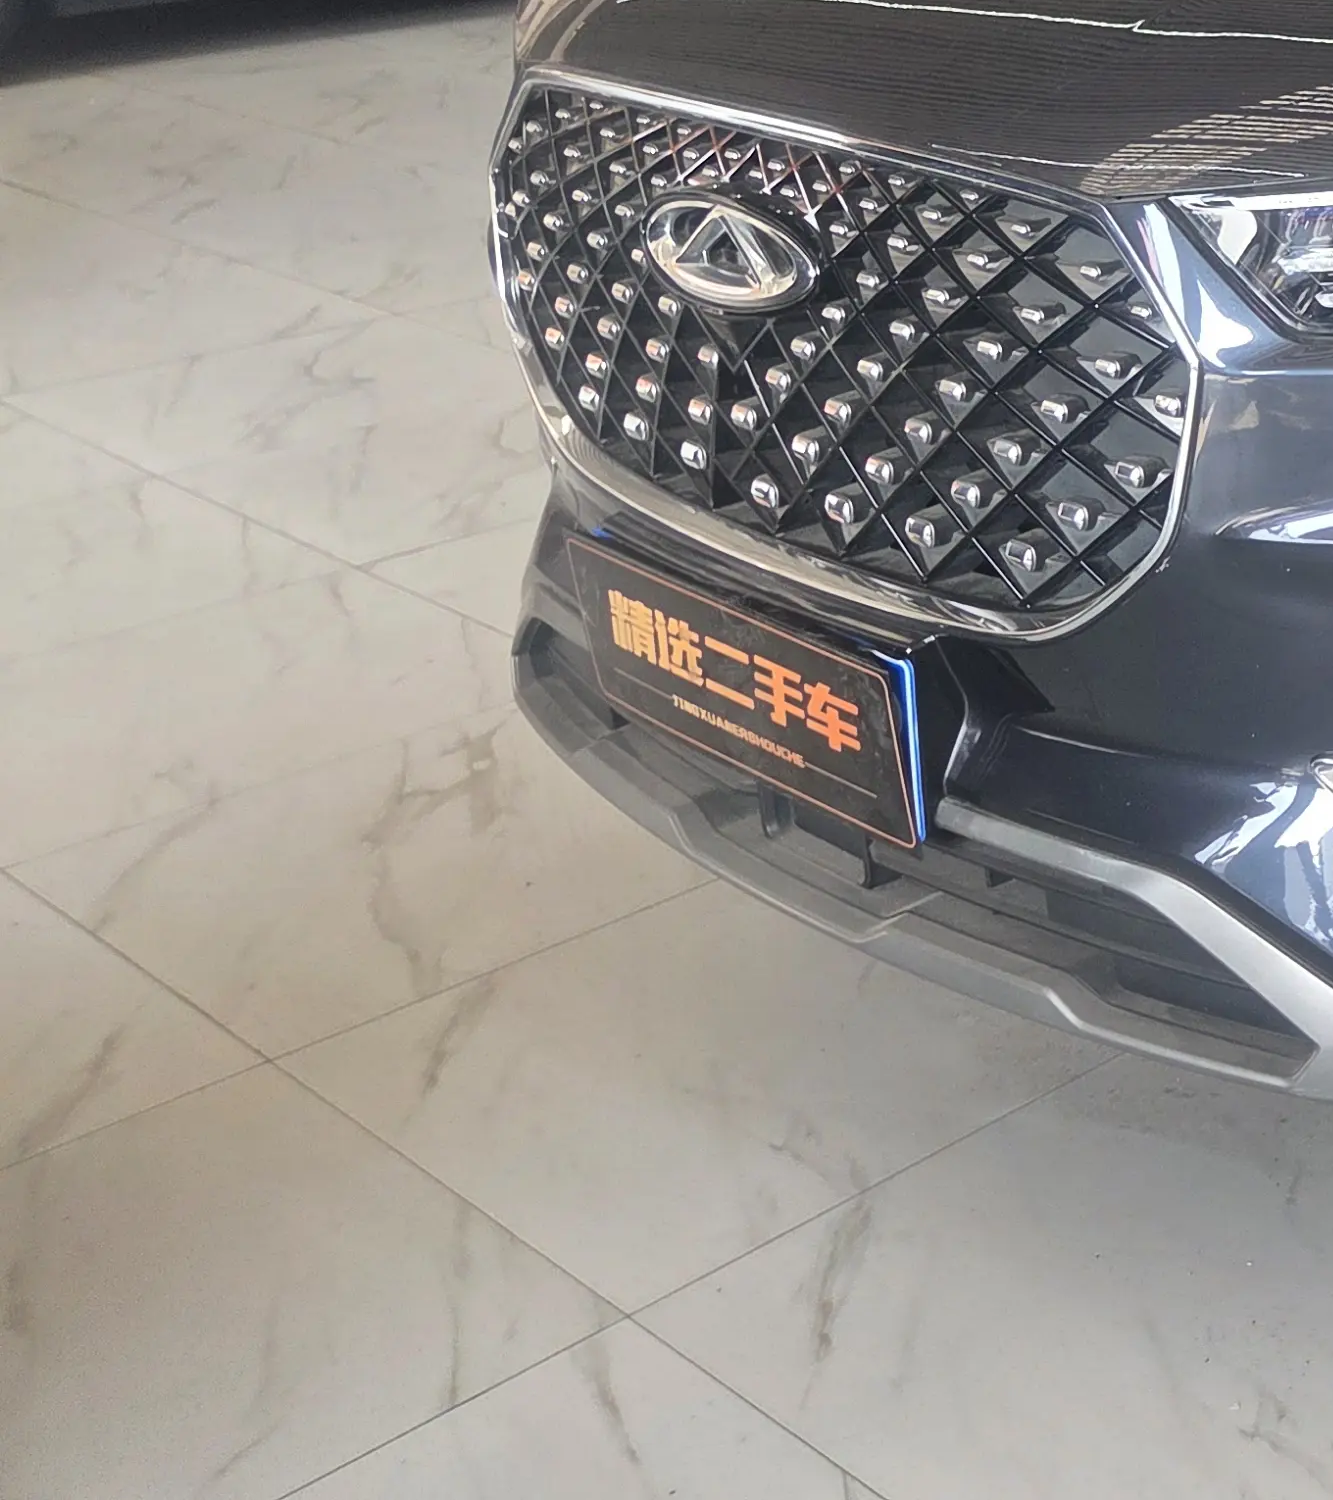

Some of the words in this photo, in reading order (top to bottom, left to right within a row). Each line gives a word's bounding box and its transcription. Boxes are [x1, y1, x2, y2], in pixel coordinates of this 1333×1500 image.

[608, 589, 862, 752] 精选二手车
